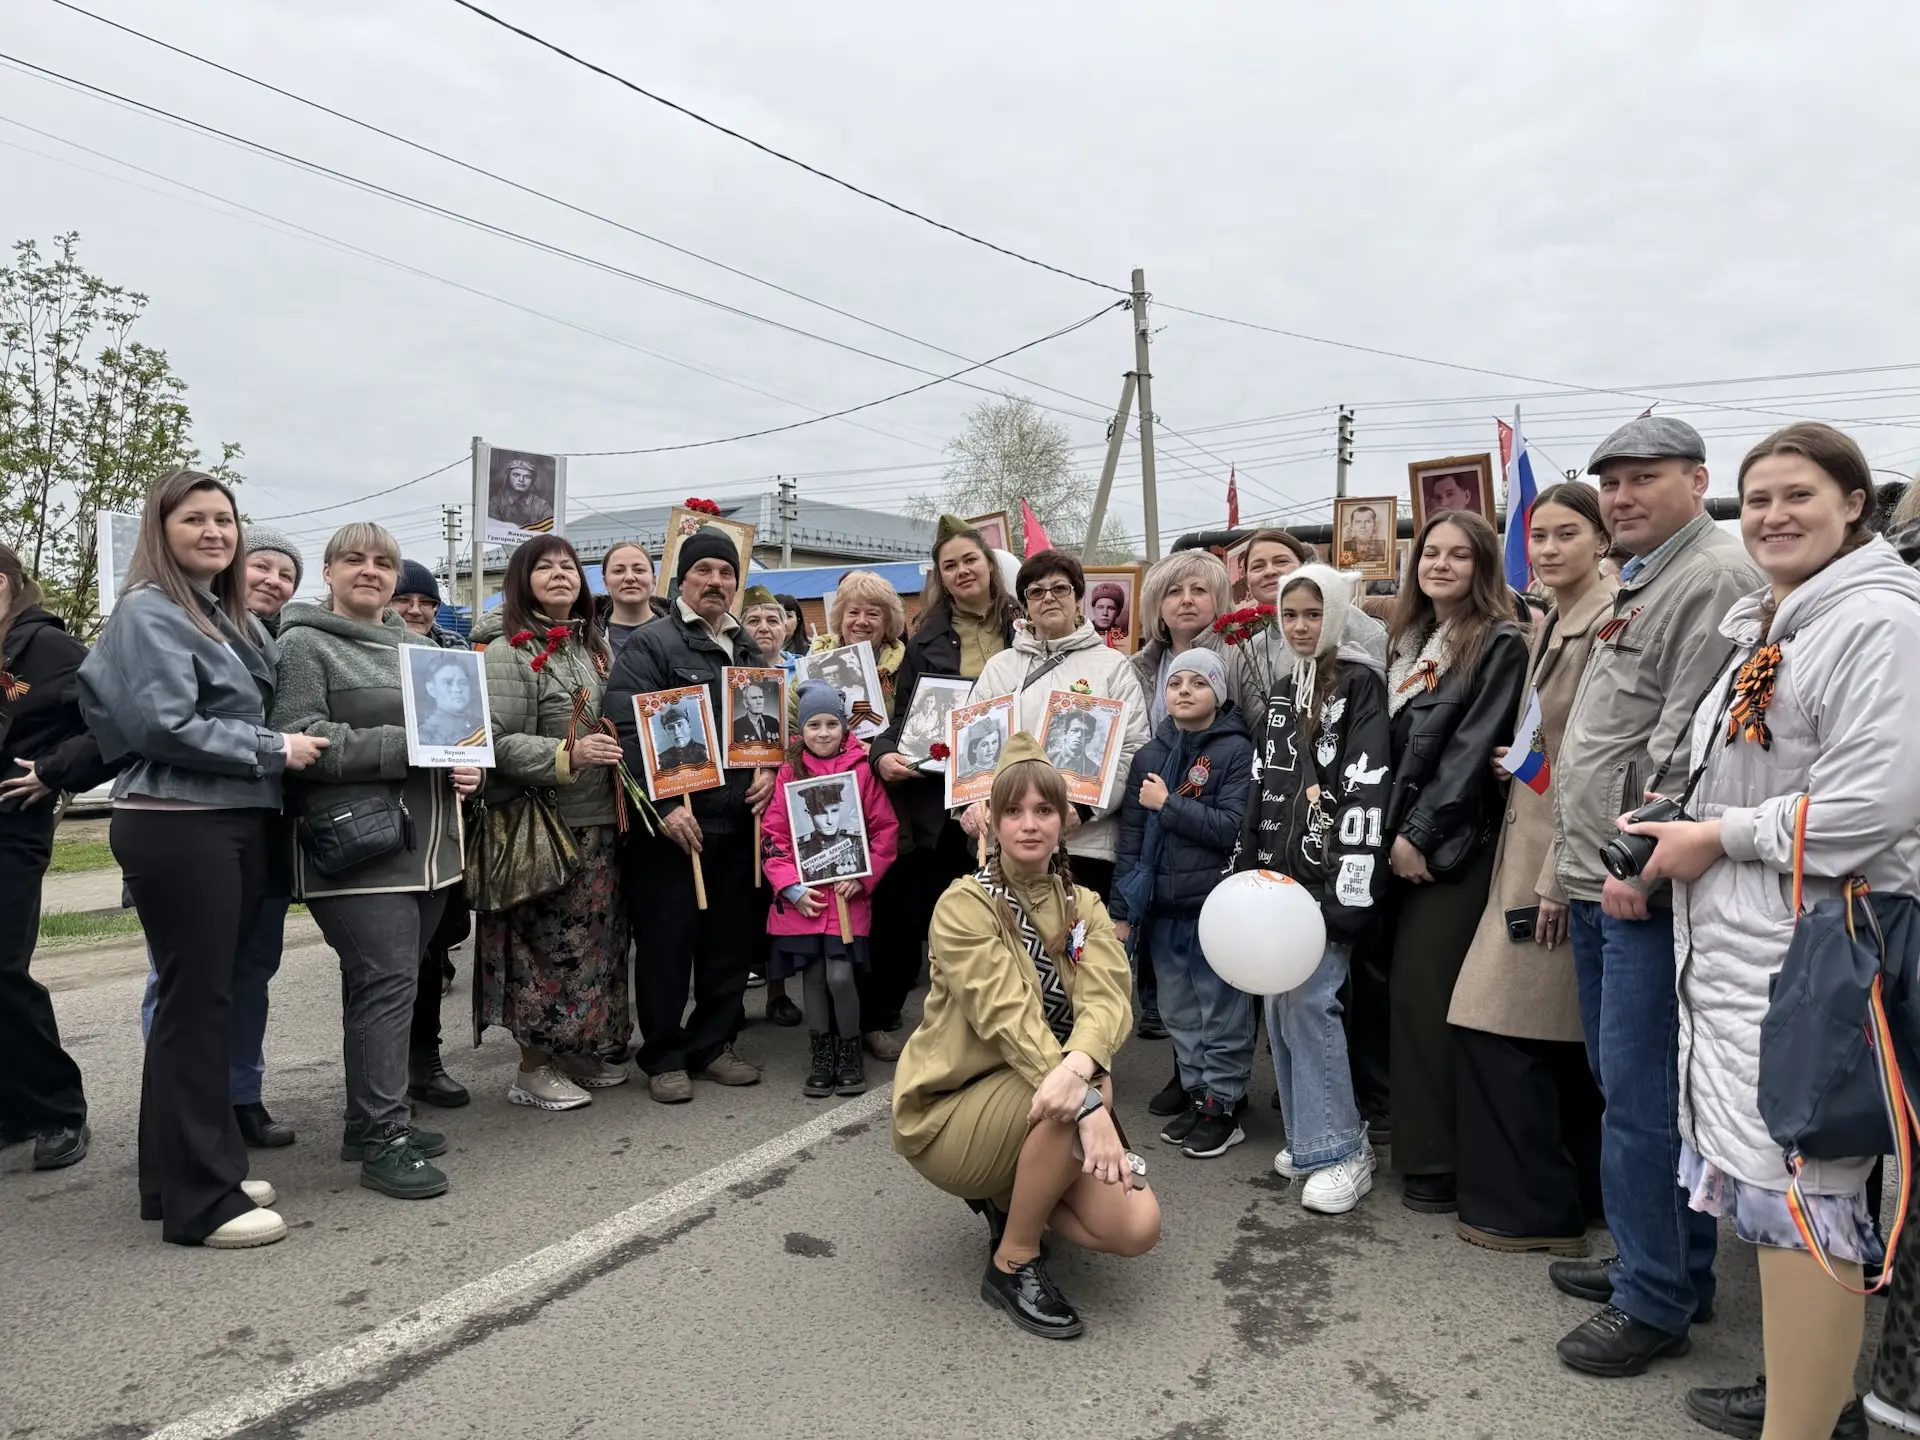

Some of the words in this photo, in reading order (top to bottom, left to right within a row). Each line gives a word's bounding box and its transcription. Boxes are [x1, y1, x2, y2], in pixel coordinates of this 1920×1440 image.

[487, 534, 516, 543] Григорий
[685, 778, 717, 789] Андреевич
[952, 796, 969, 804] Ольга
[1261, 789, 1285, 803] Look
[1260, 819, 1282, 831] Not
[1339, 806, 1382, 847] 01
[803, 853, 827, 868] КУТЕРГИН
[829, 840, 851, 855] АЛЕКСЕЙ
[1346, 862, 1366, 872] Trust
[1349, 877, 1364, 885] your
[1342, 883, 1365, 894] Magic
